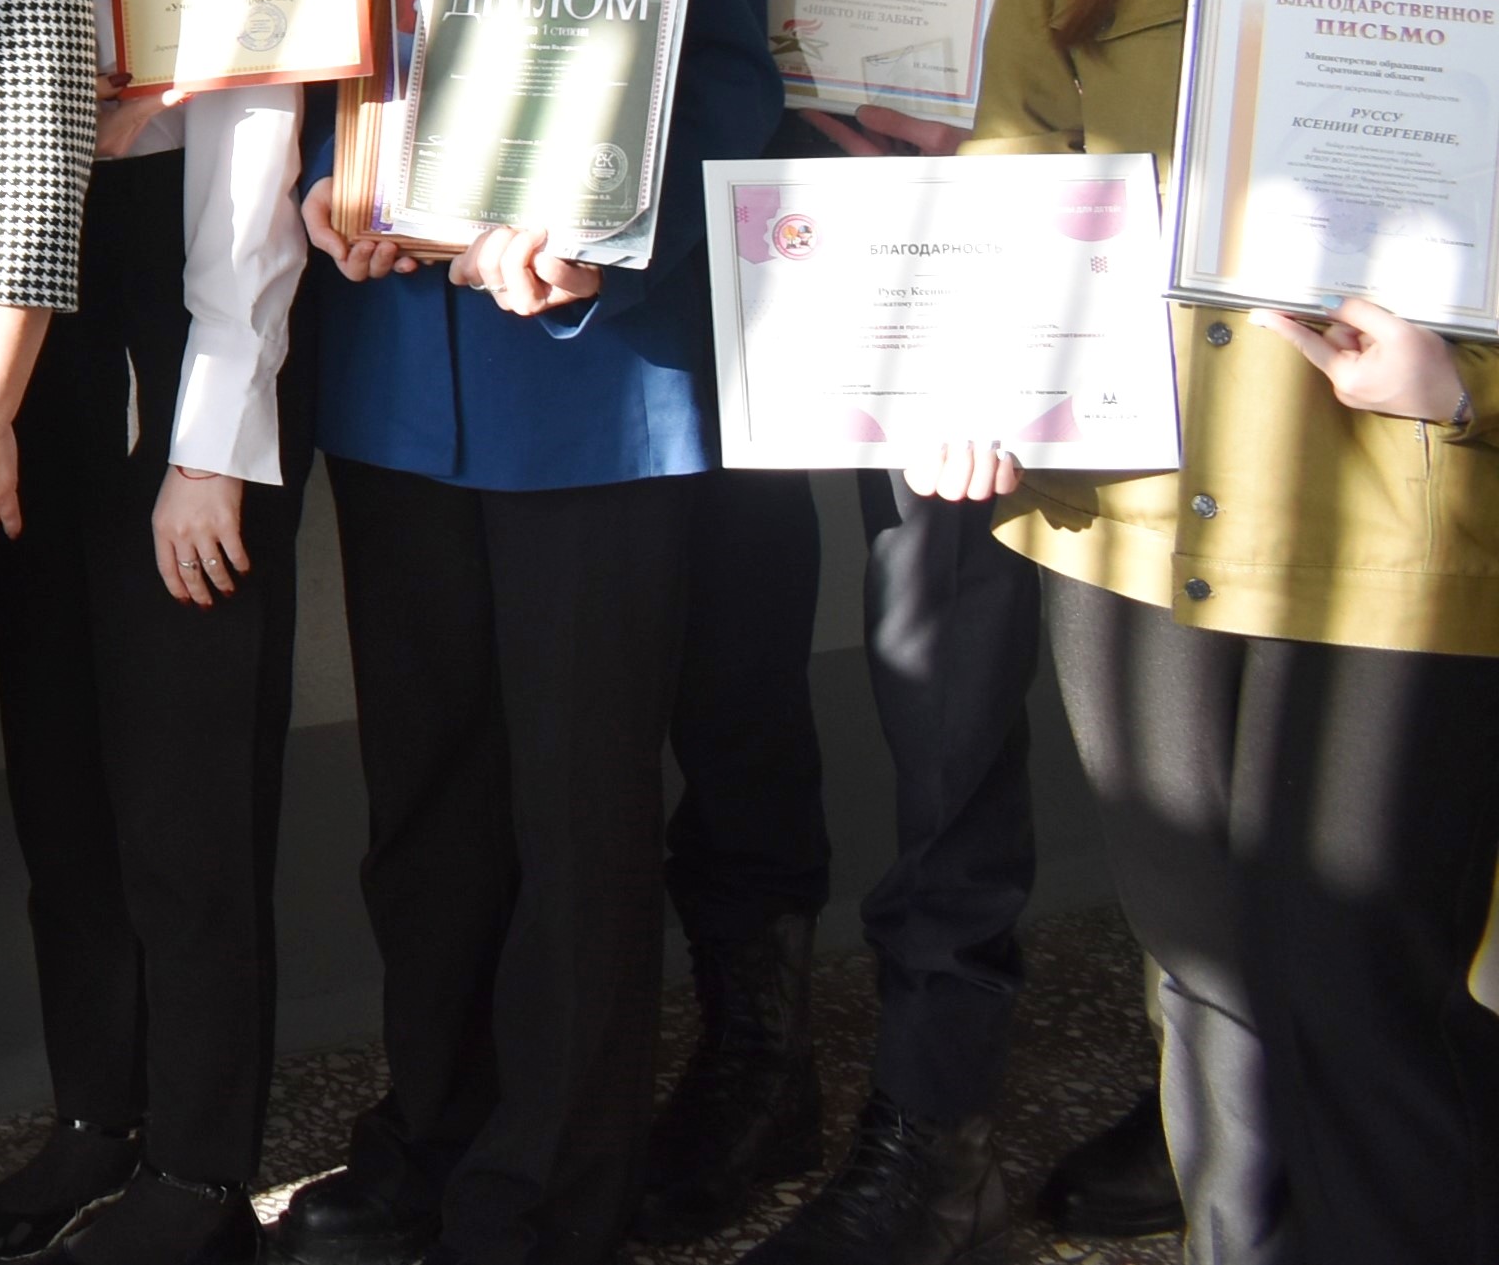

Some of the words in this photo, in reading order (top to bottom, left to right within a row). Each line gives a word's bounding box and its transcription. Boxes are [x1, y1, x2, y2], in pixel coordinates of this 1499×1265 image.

[803, 3, 854, 19] «НИКТО
[857, 9, 875, 21] НЕ
[877, 10, 930, 27] ЗАБЫТ»
[1315, 18, 1447, 46] ПИСЬМО
[1305, 50, 1378, 67] Министерство
[1379, 59, 1444, 74] образования
[1317, 63, 1383, 78] Саратовской
[1384, 71, 1426, 88] области
[1351, 107, 1404, 123] РУССУ
[1292, 116, 1358, 134] КСЕНИИ
[1362, 124, 1460, 146] СЕРГЕЕВНЕ,
[870, 243, 1002, 257] БЛАГОДАРНОСТЬ
